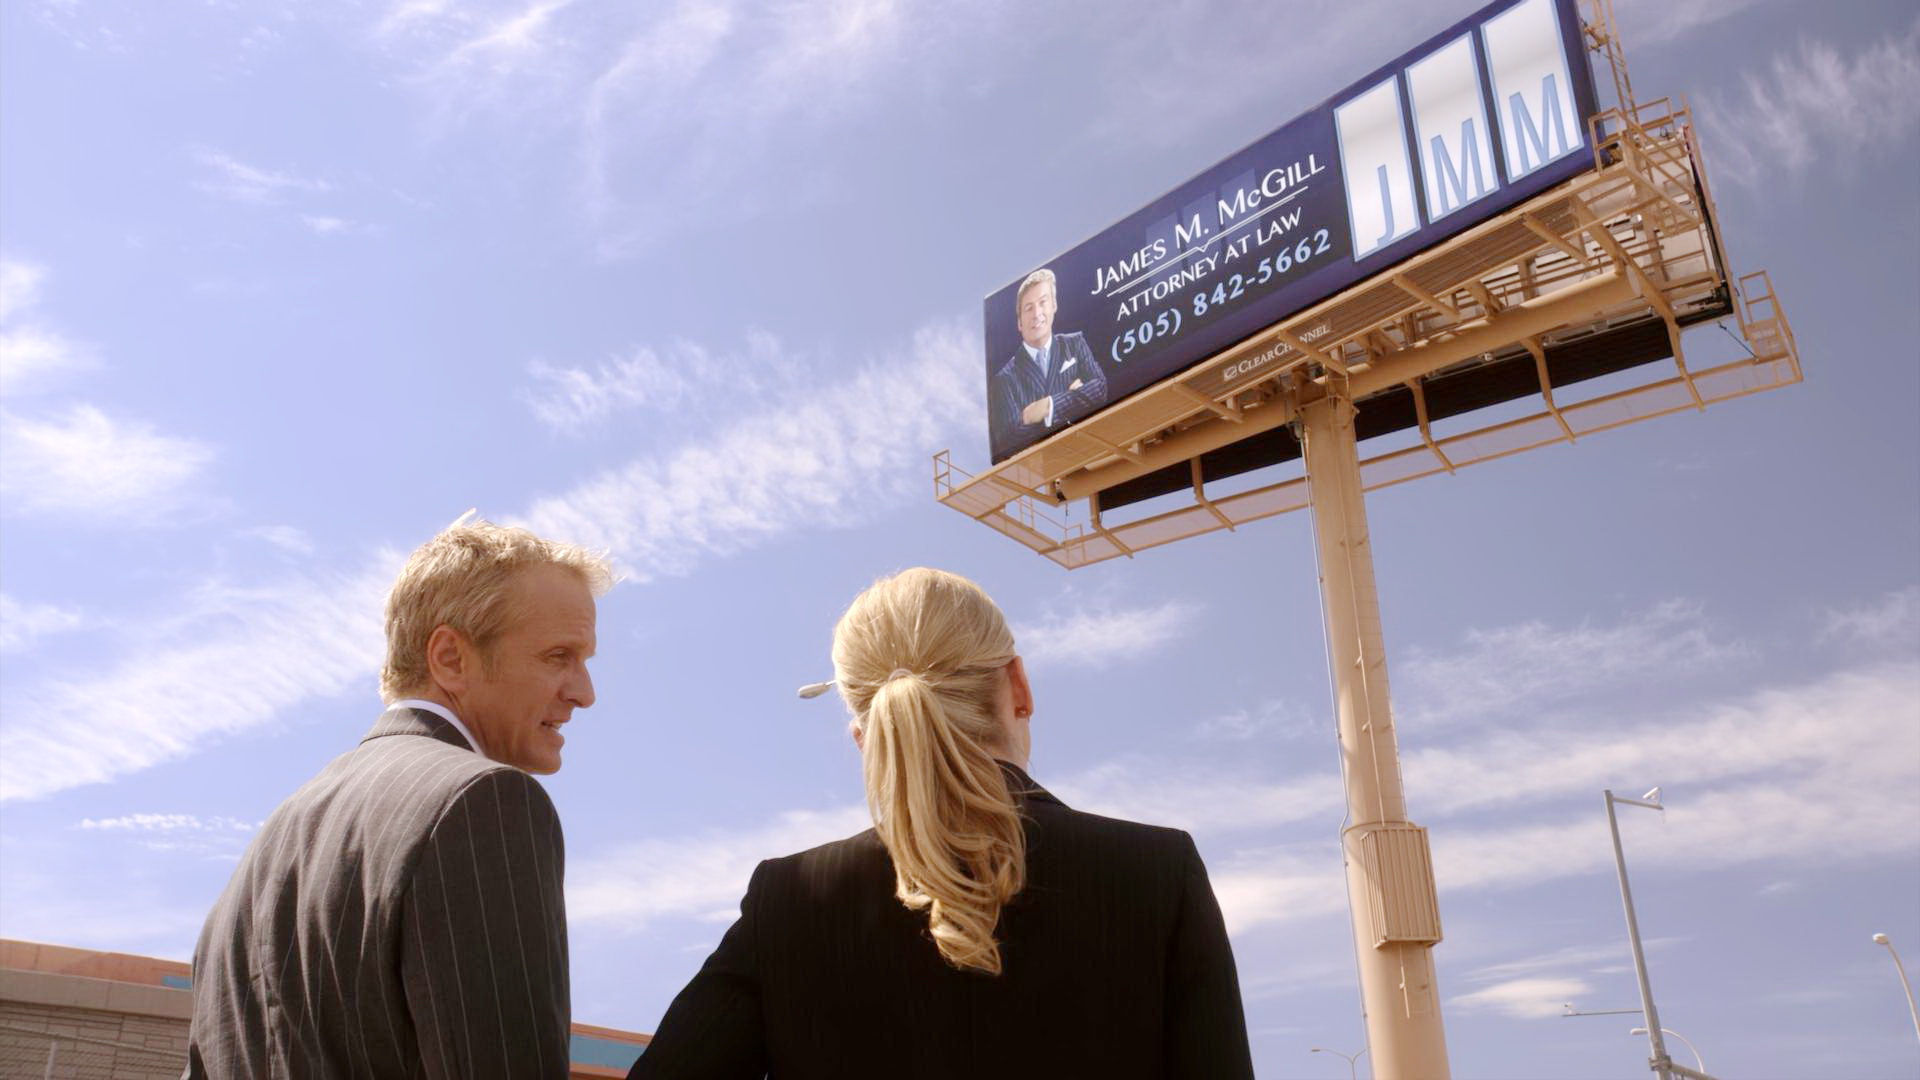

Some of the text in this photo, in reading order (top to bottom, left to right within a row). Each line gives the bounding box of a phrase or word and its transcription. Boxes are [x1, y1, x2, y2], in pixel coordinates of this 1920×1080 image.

[1091, 153, 1325, 295] JAMES M. McGILL
[1117, 207, 1301, 321] ATTORNEY AT LAW
[1111, 228, 1331, 362] (505) 842-5662
